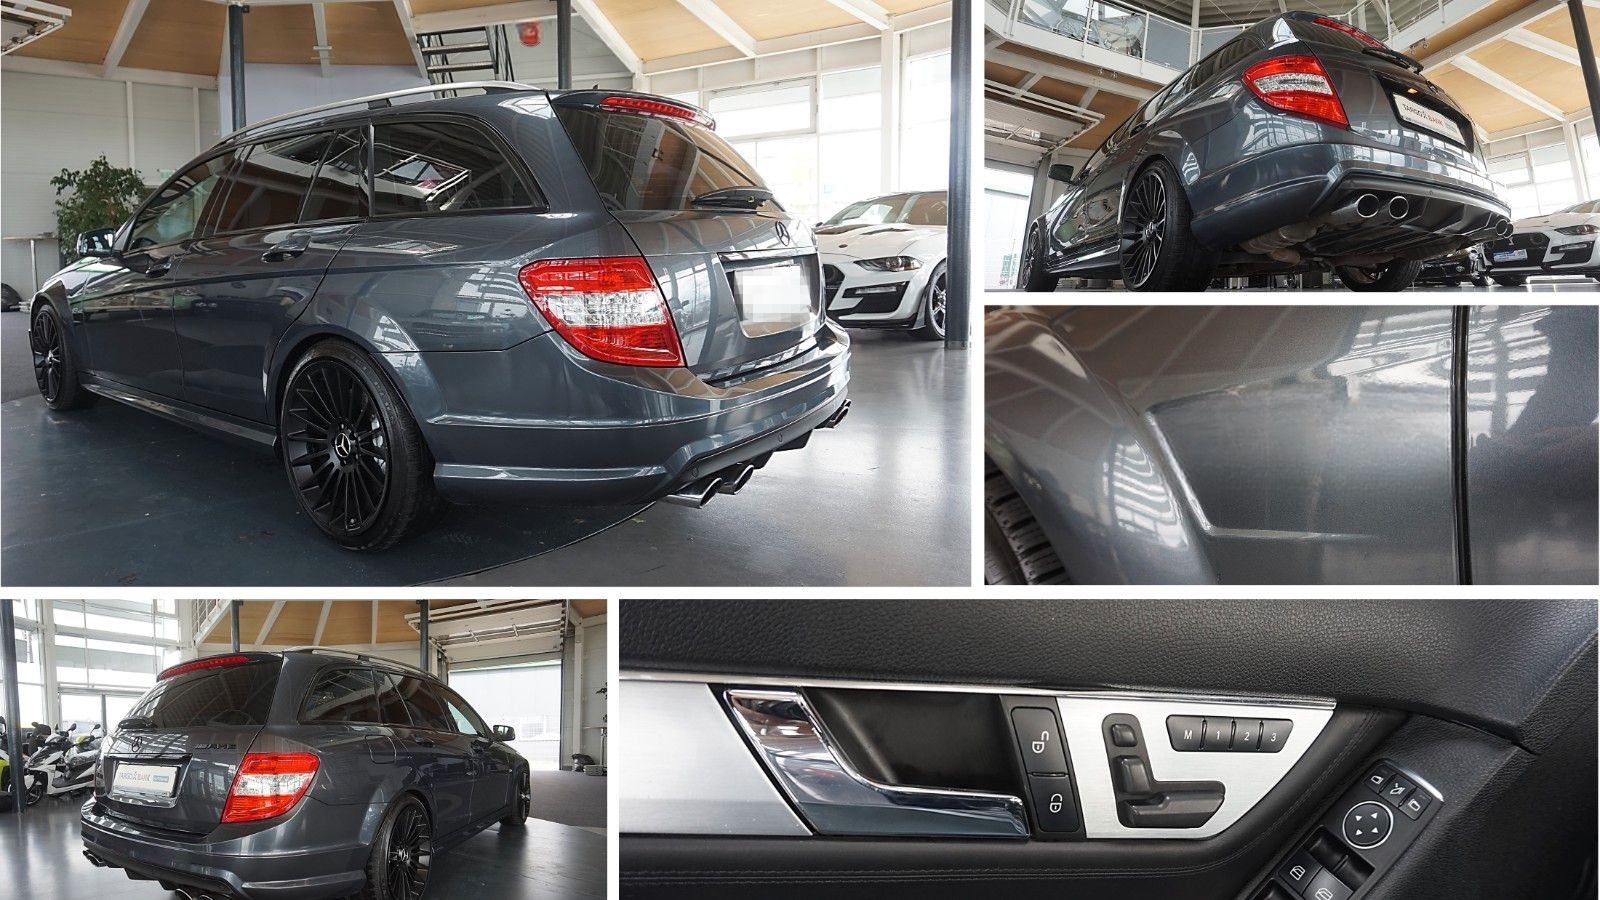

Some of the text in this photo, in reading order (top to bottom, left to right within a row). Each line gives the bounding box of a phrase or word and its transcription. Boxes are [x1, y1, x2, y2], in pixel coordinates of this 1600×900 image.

[1183, 729, 1277, 742] M 1 2 3
